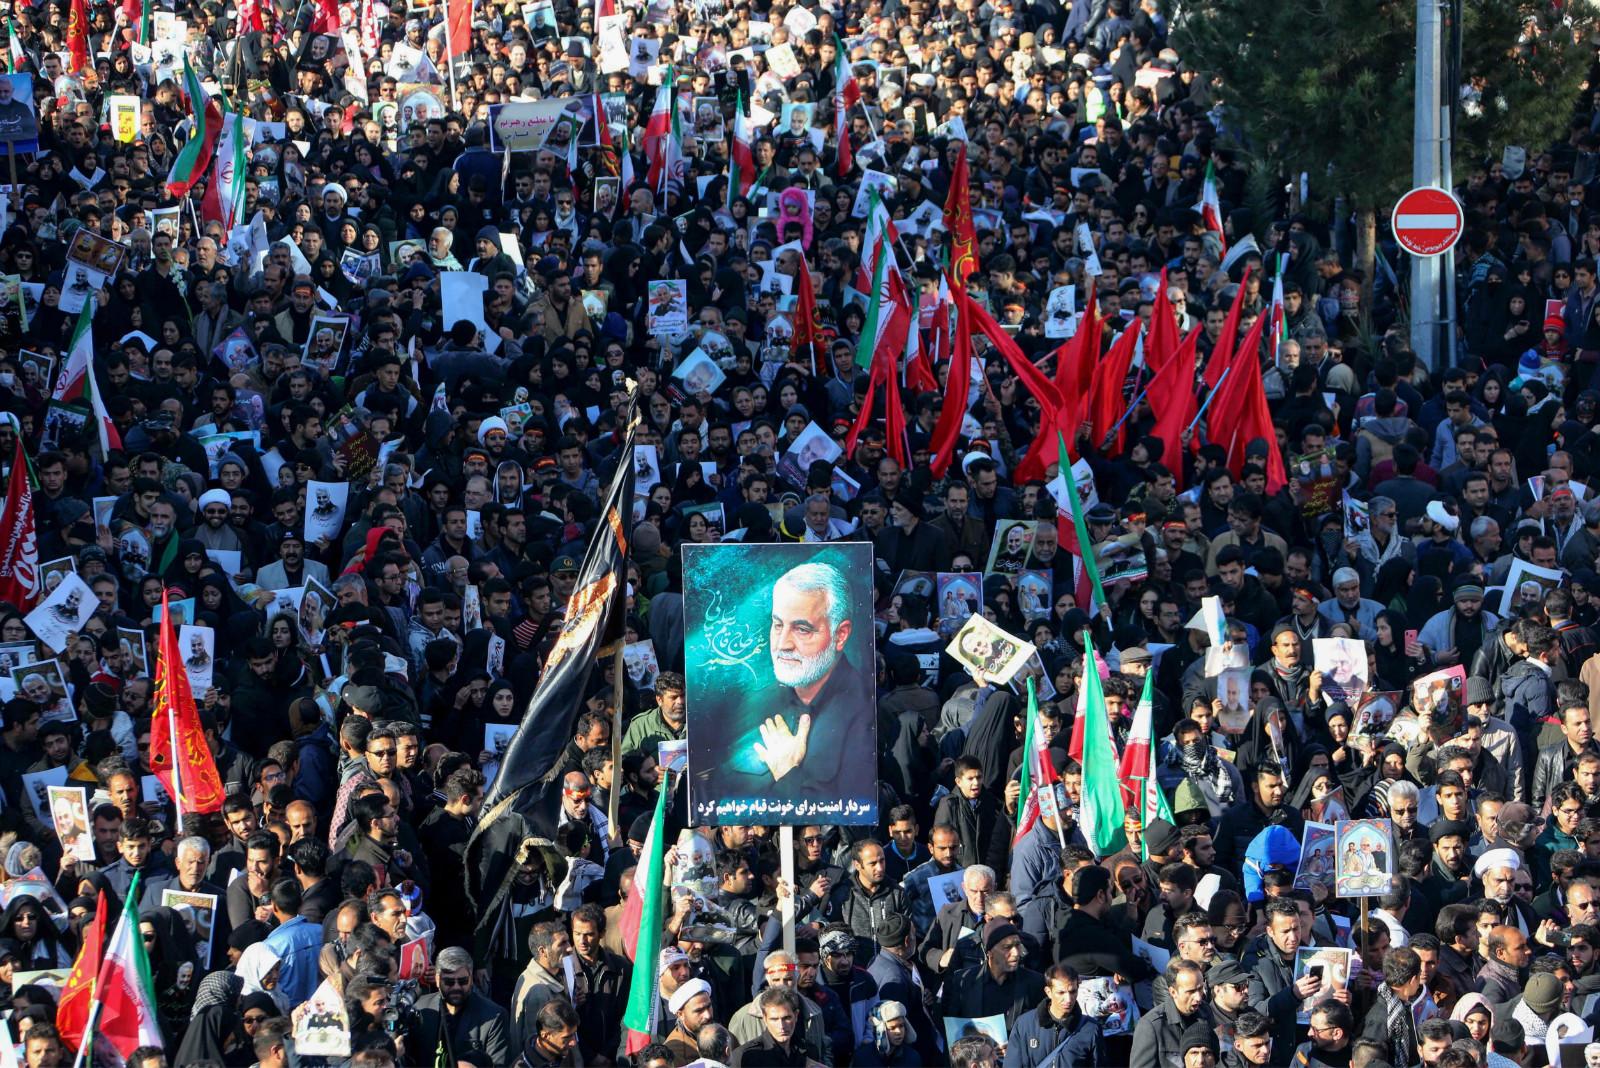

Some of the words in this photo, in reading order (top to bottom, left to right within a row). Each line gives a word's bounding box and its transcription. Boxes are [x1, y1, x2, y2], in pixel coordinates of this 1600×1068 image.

[697, 799, 715, 817] کرد
[716, 799, 748, 816] خواهیم
[749, 798, 767, 816] قیام
[767, 799, 795, 816] خونت
[795, 799, 817, 816] برای
[817, 799, 843, 814] امنیت
[843, 799, 871, 816] سردار
